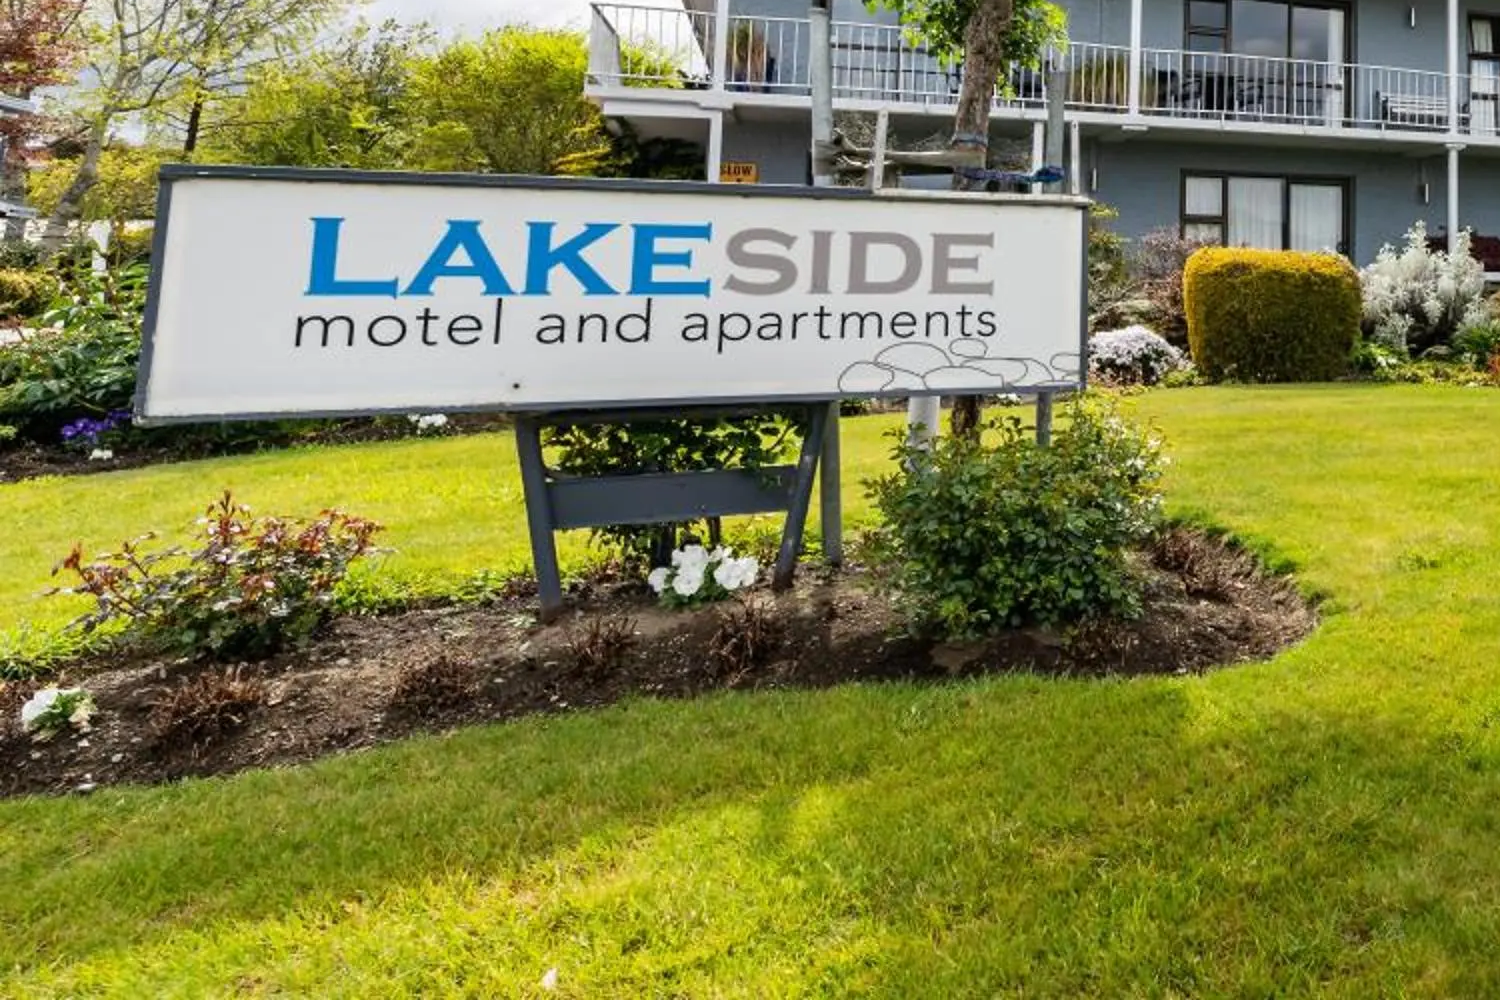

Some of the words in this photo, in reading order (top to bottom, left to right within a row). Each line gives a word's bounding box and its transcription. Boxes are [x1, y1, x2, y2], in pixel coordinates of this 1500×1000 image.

[303, 216, 995, 299] LAKESIDE
[293, 297, 504, 348] motel
[535, 296, 653, 345] and
[680, 305, 997, 355] apartments
